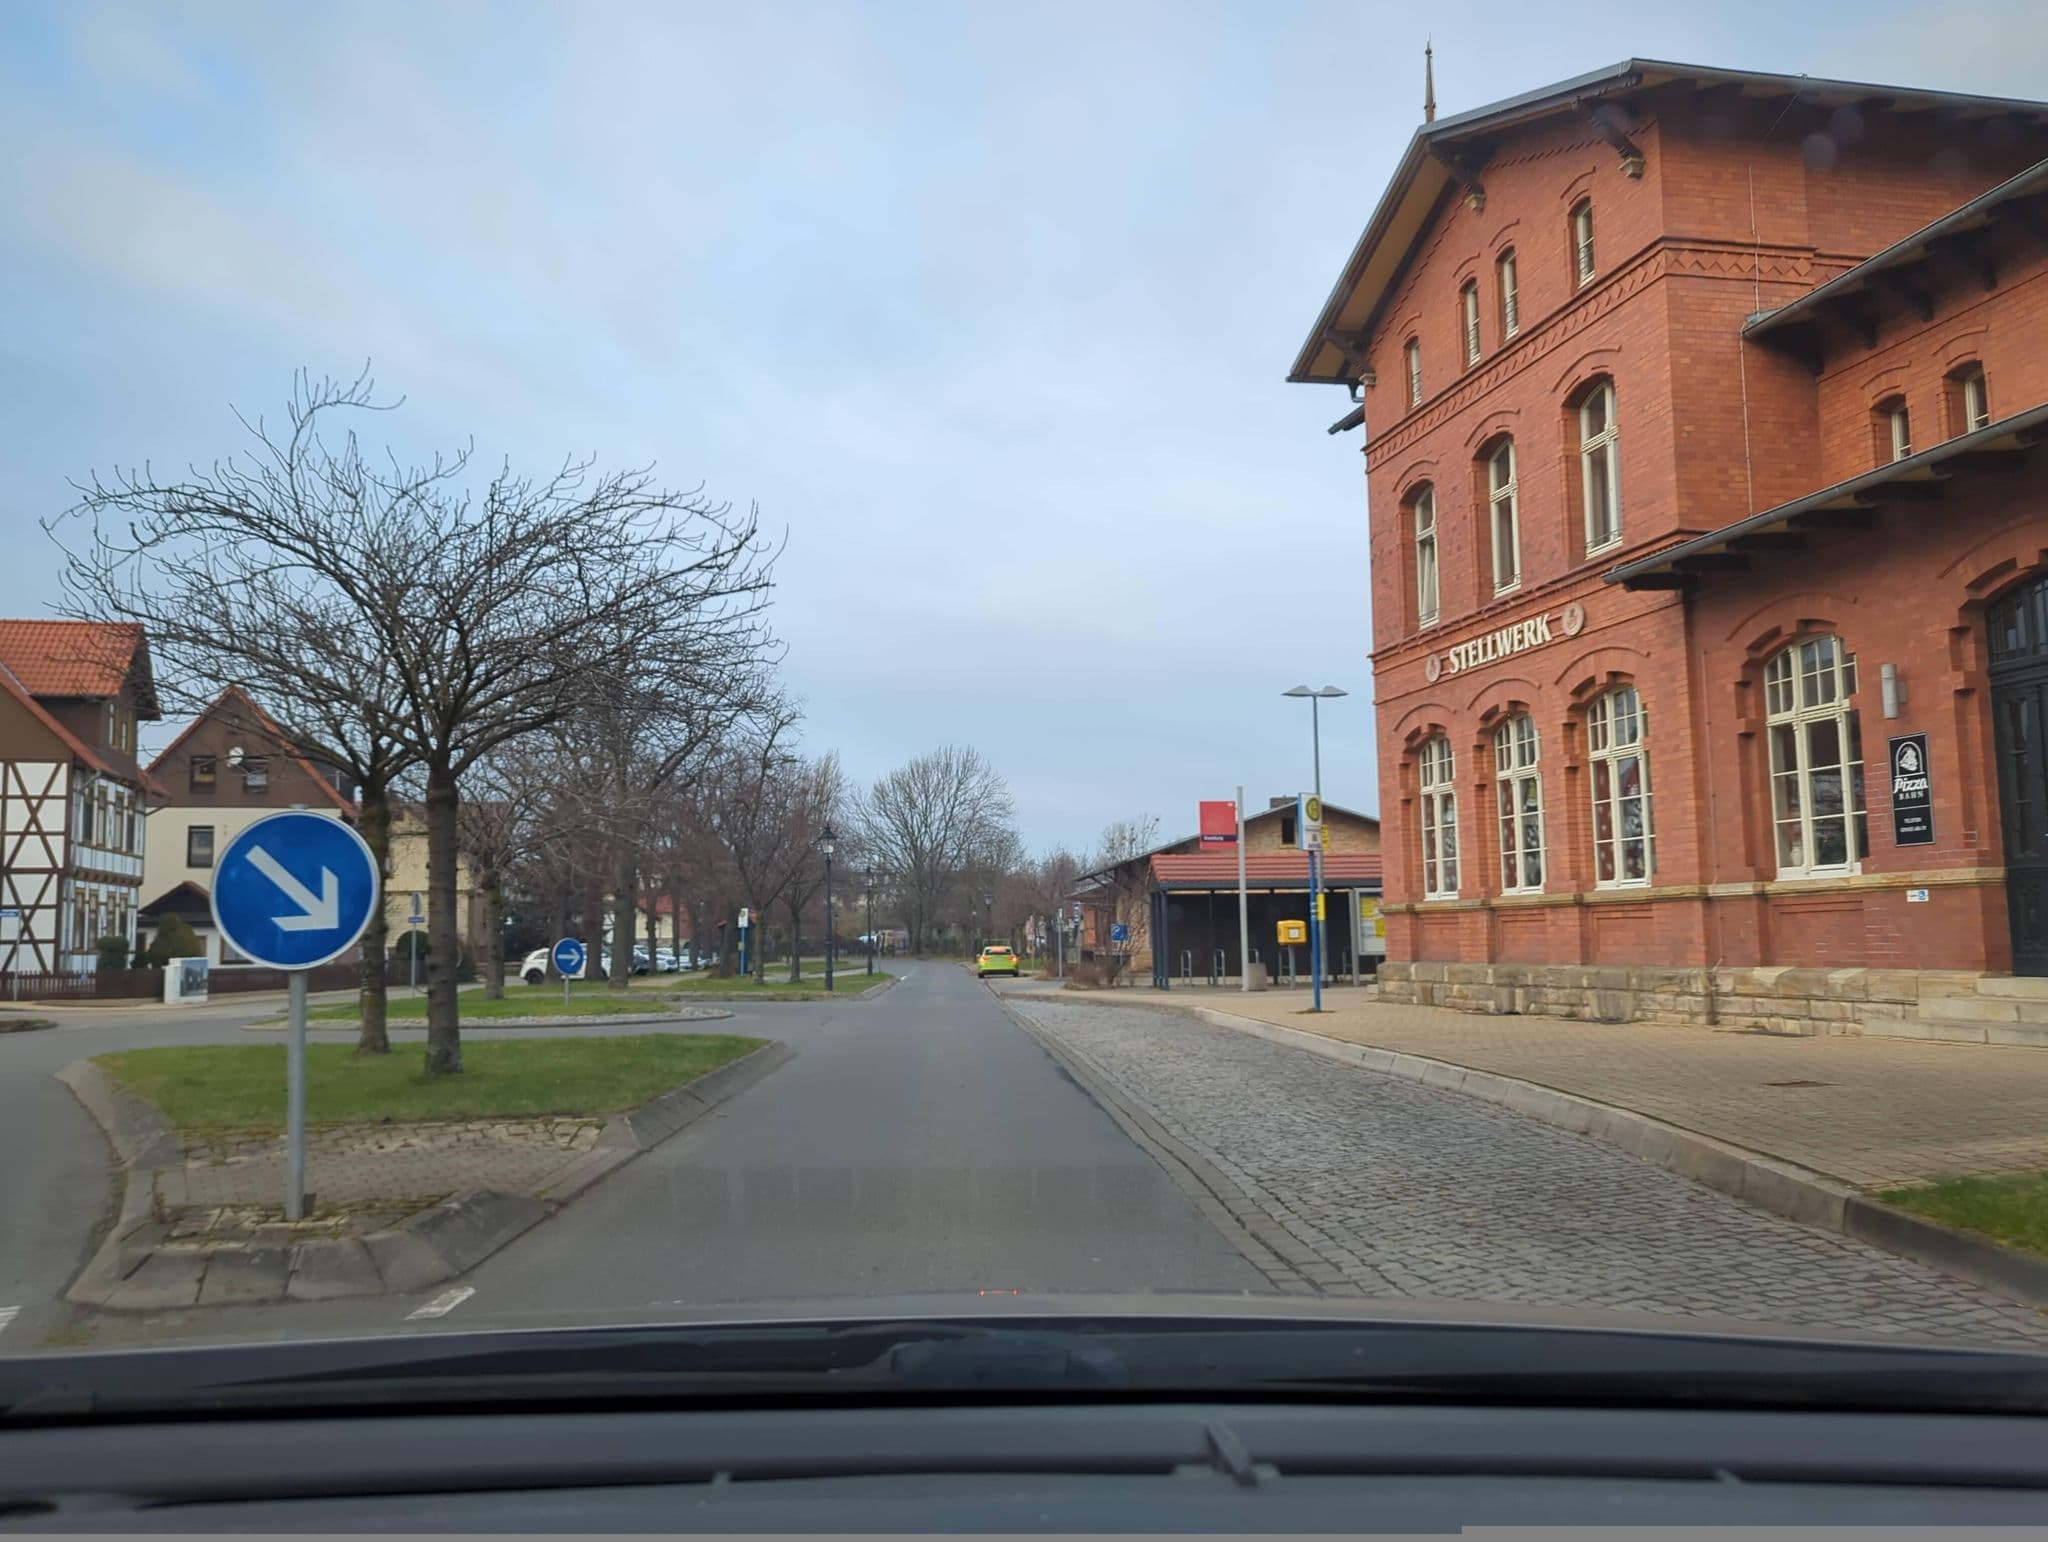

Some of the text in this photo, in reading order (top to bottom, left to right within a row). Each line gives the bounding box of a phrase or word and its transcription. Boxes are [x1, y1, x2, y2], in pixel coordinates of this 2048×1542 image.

[1450, 613, 1553, 674] STELLWERK
[1893, 777, 1929, 794] Pizza
[1899, 790, 1924, 801] BAHN
